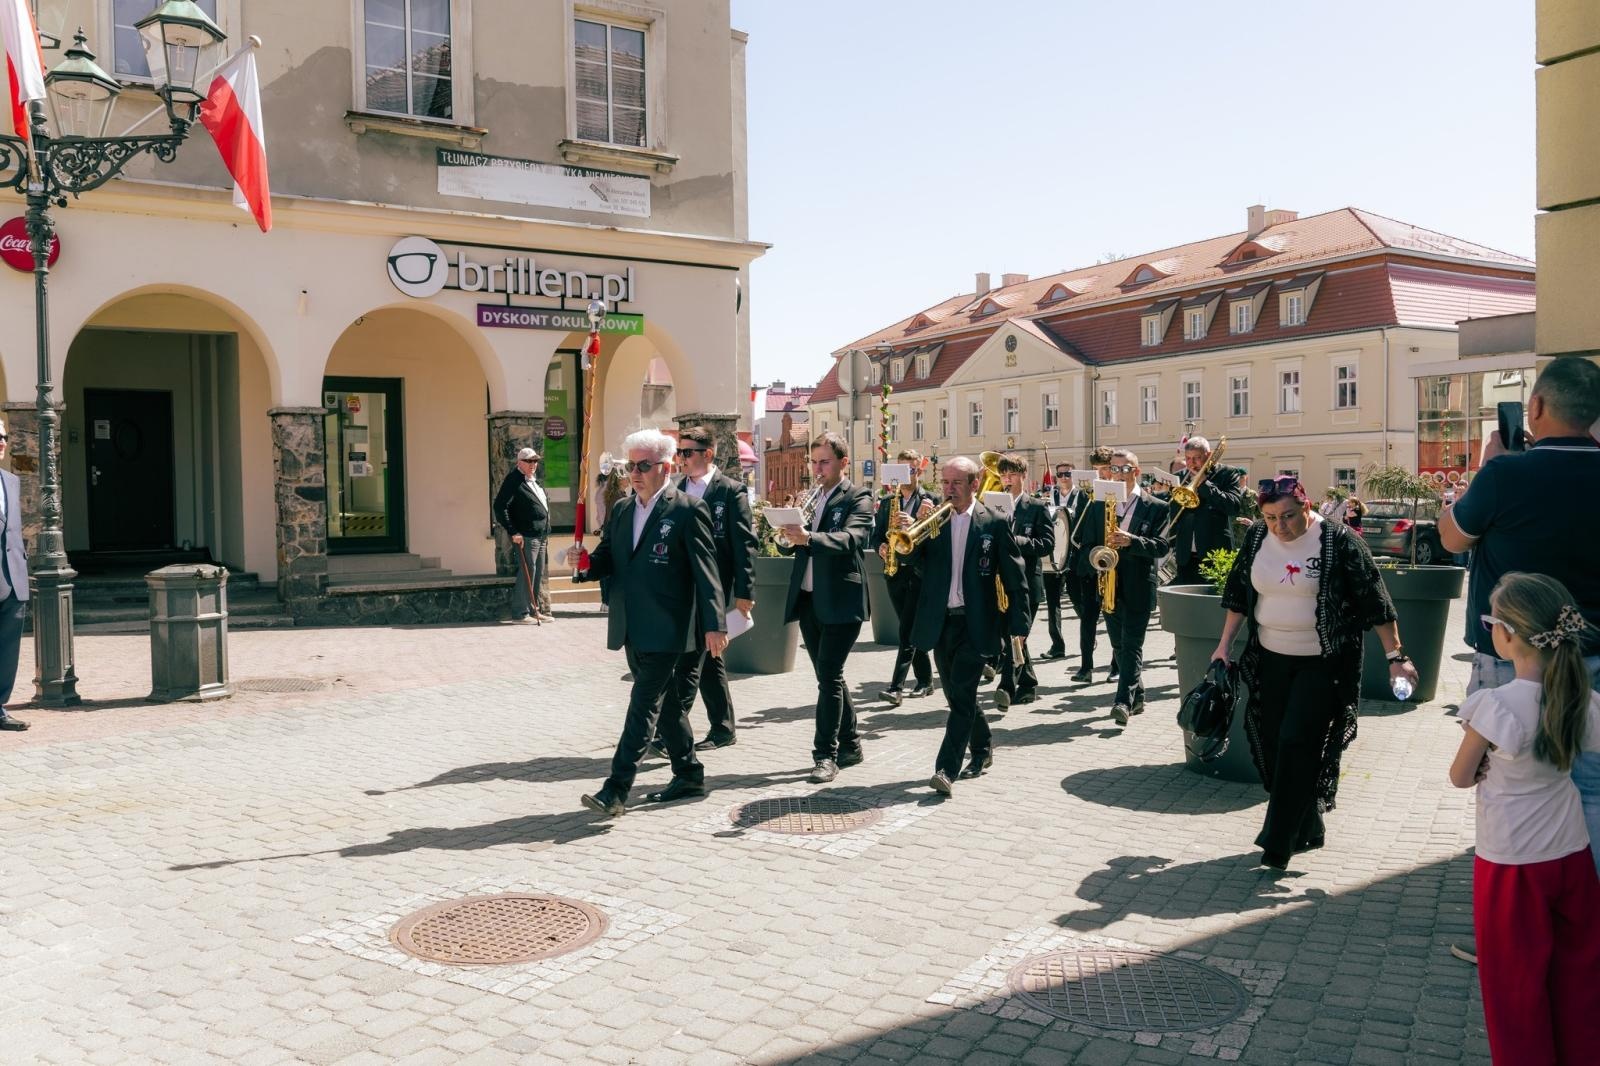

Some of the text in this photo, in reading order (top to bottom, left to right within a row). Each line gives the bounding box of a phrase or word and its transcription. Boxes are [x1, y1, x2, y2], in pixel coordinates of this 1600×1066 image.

[440, 151, 489, 167] TŁUMACZ
[458, 251, 634, 309] brillen.pl
[482, 311, 639, 331] DYSKONT OKULROWY
